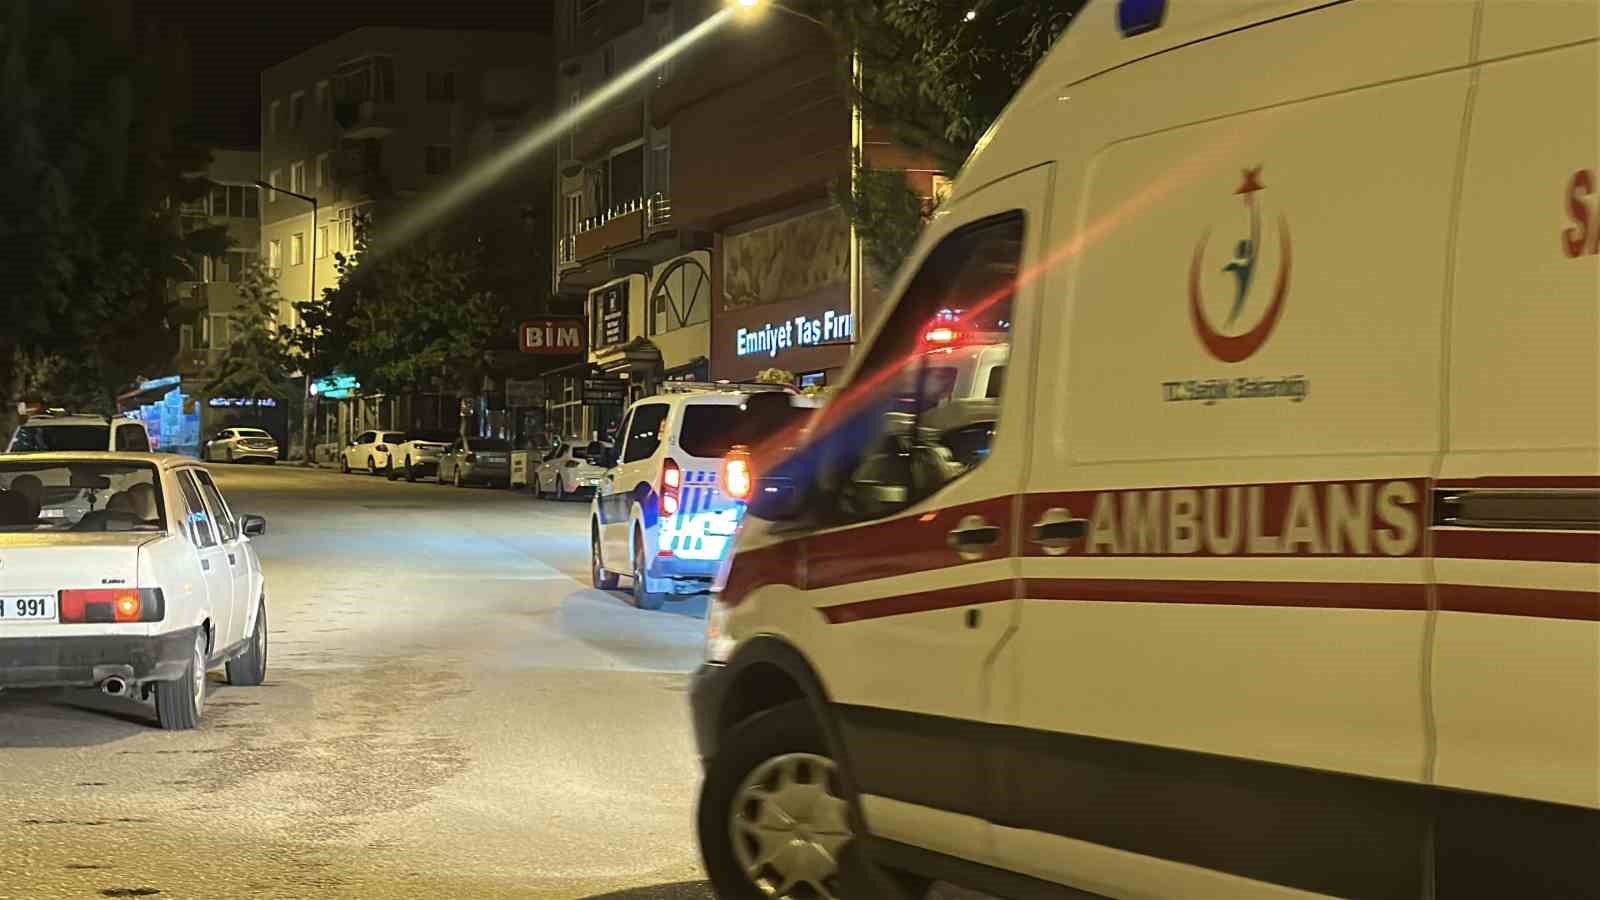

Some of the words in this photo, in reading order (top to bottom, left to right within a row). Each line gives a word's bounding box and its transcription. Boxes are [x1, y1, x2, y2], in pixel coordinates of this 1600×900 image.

[526, 321, 580, 348] BİM
[736, 321, 792, 357] Emniyet
[795, 315, 821, 345] Taş
[1086, 480, 1419, 556] AMBULANS
[16, 598, 46, 616] 991
